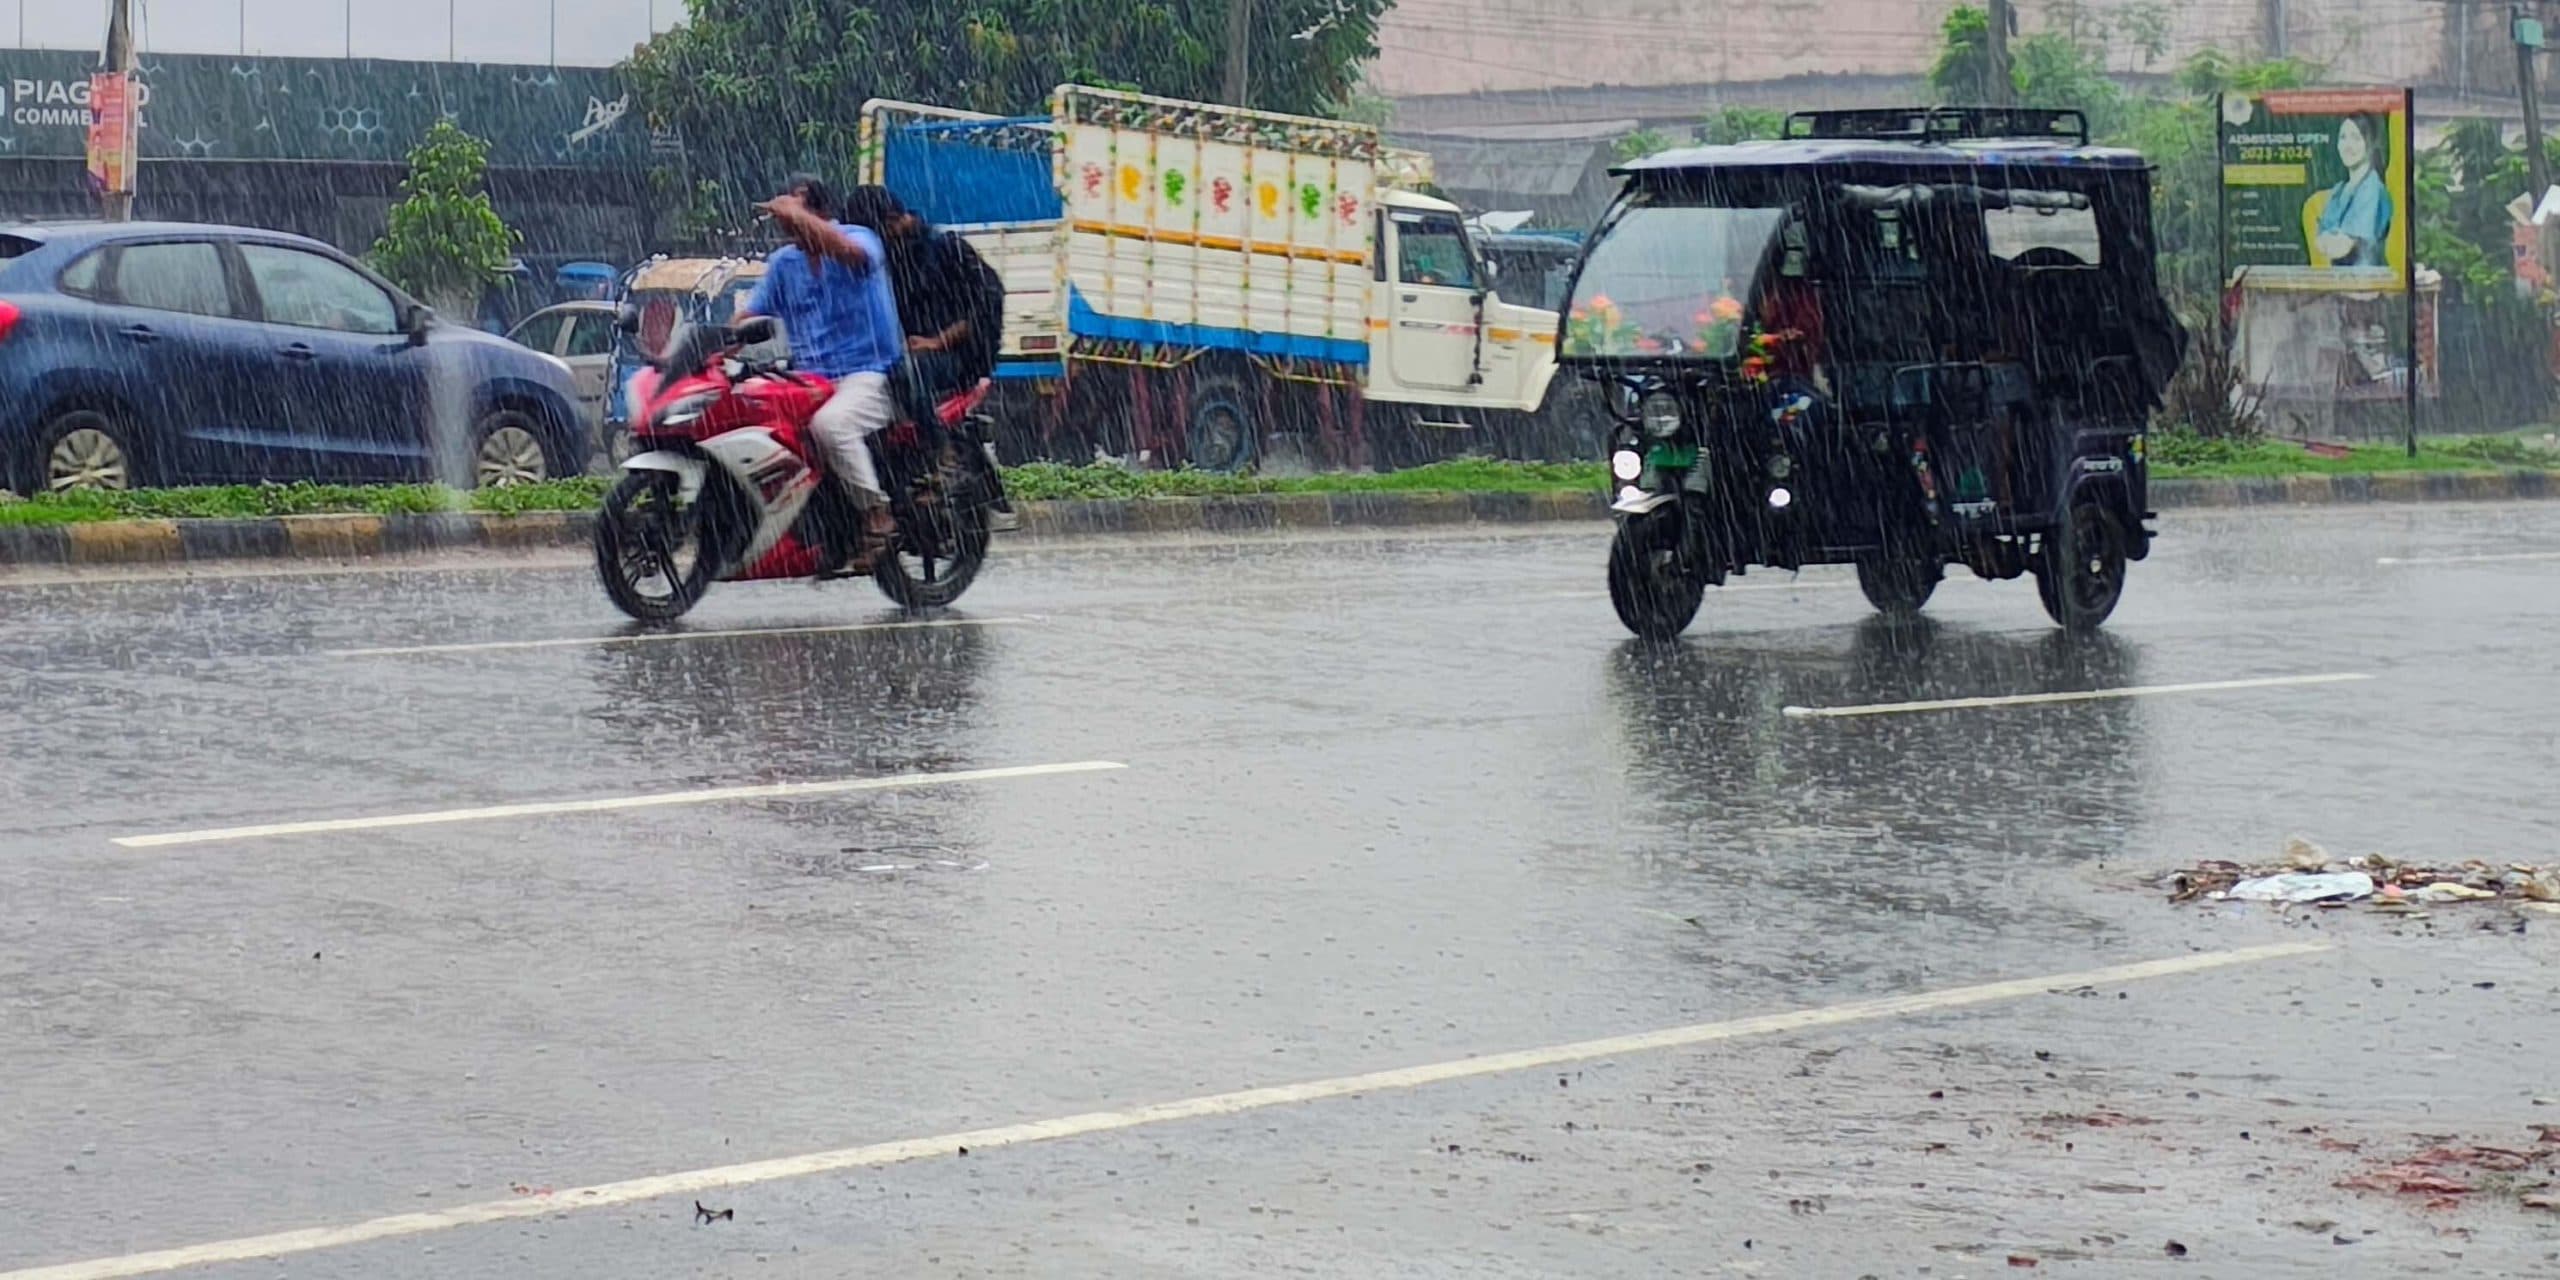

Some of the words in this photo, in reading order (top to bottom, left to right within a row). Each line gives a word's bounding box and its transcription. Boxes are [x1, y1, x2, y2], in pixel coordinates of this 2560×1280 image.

[14, 107, 148, 128] COMMEL
[2228, 133, 2295, 145] ADMISSION
[2297, 133, 2330, 144] OPEN
